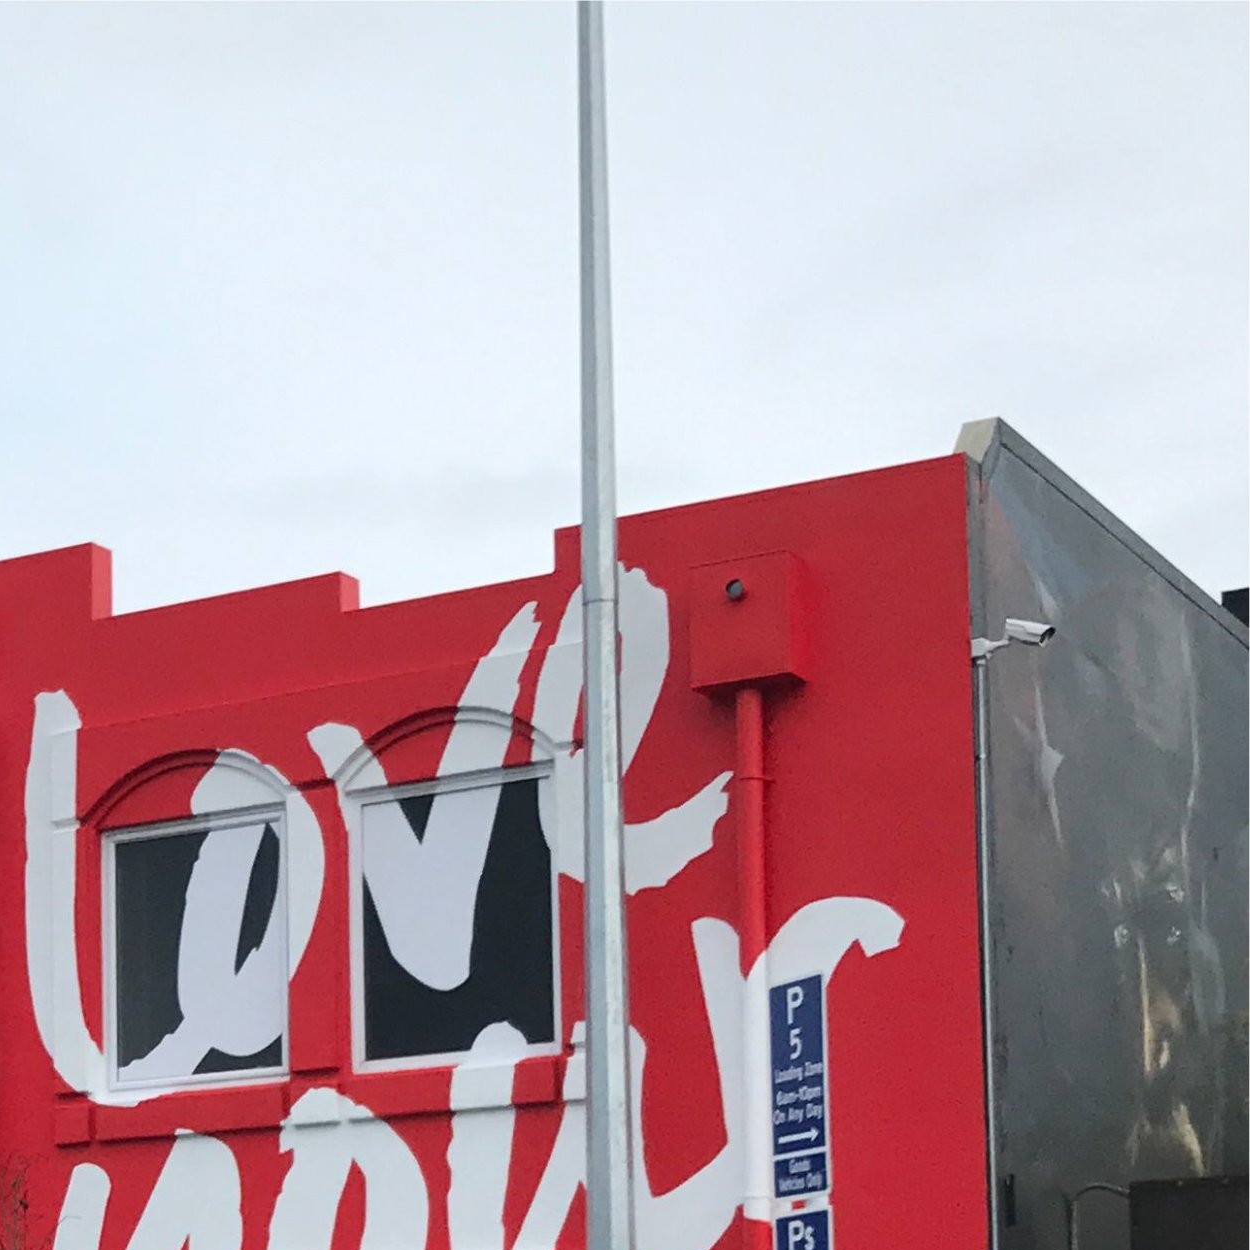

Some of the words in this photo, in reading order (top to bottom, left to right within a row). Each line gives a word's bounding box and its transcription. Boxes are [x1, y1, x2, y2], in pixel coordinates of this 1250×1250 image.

[24, 560, 734, 1108] love
[786, 985, 803, 1025] P
[789, 1027, 802, 1060] 5
